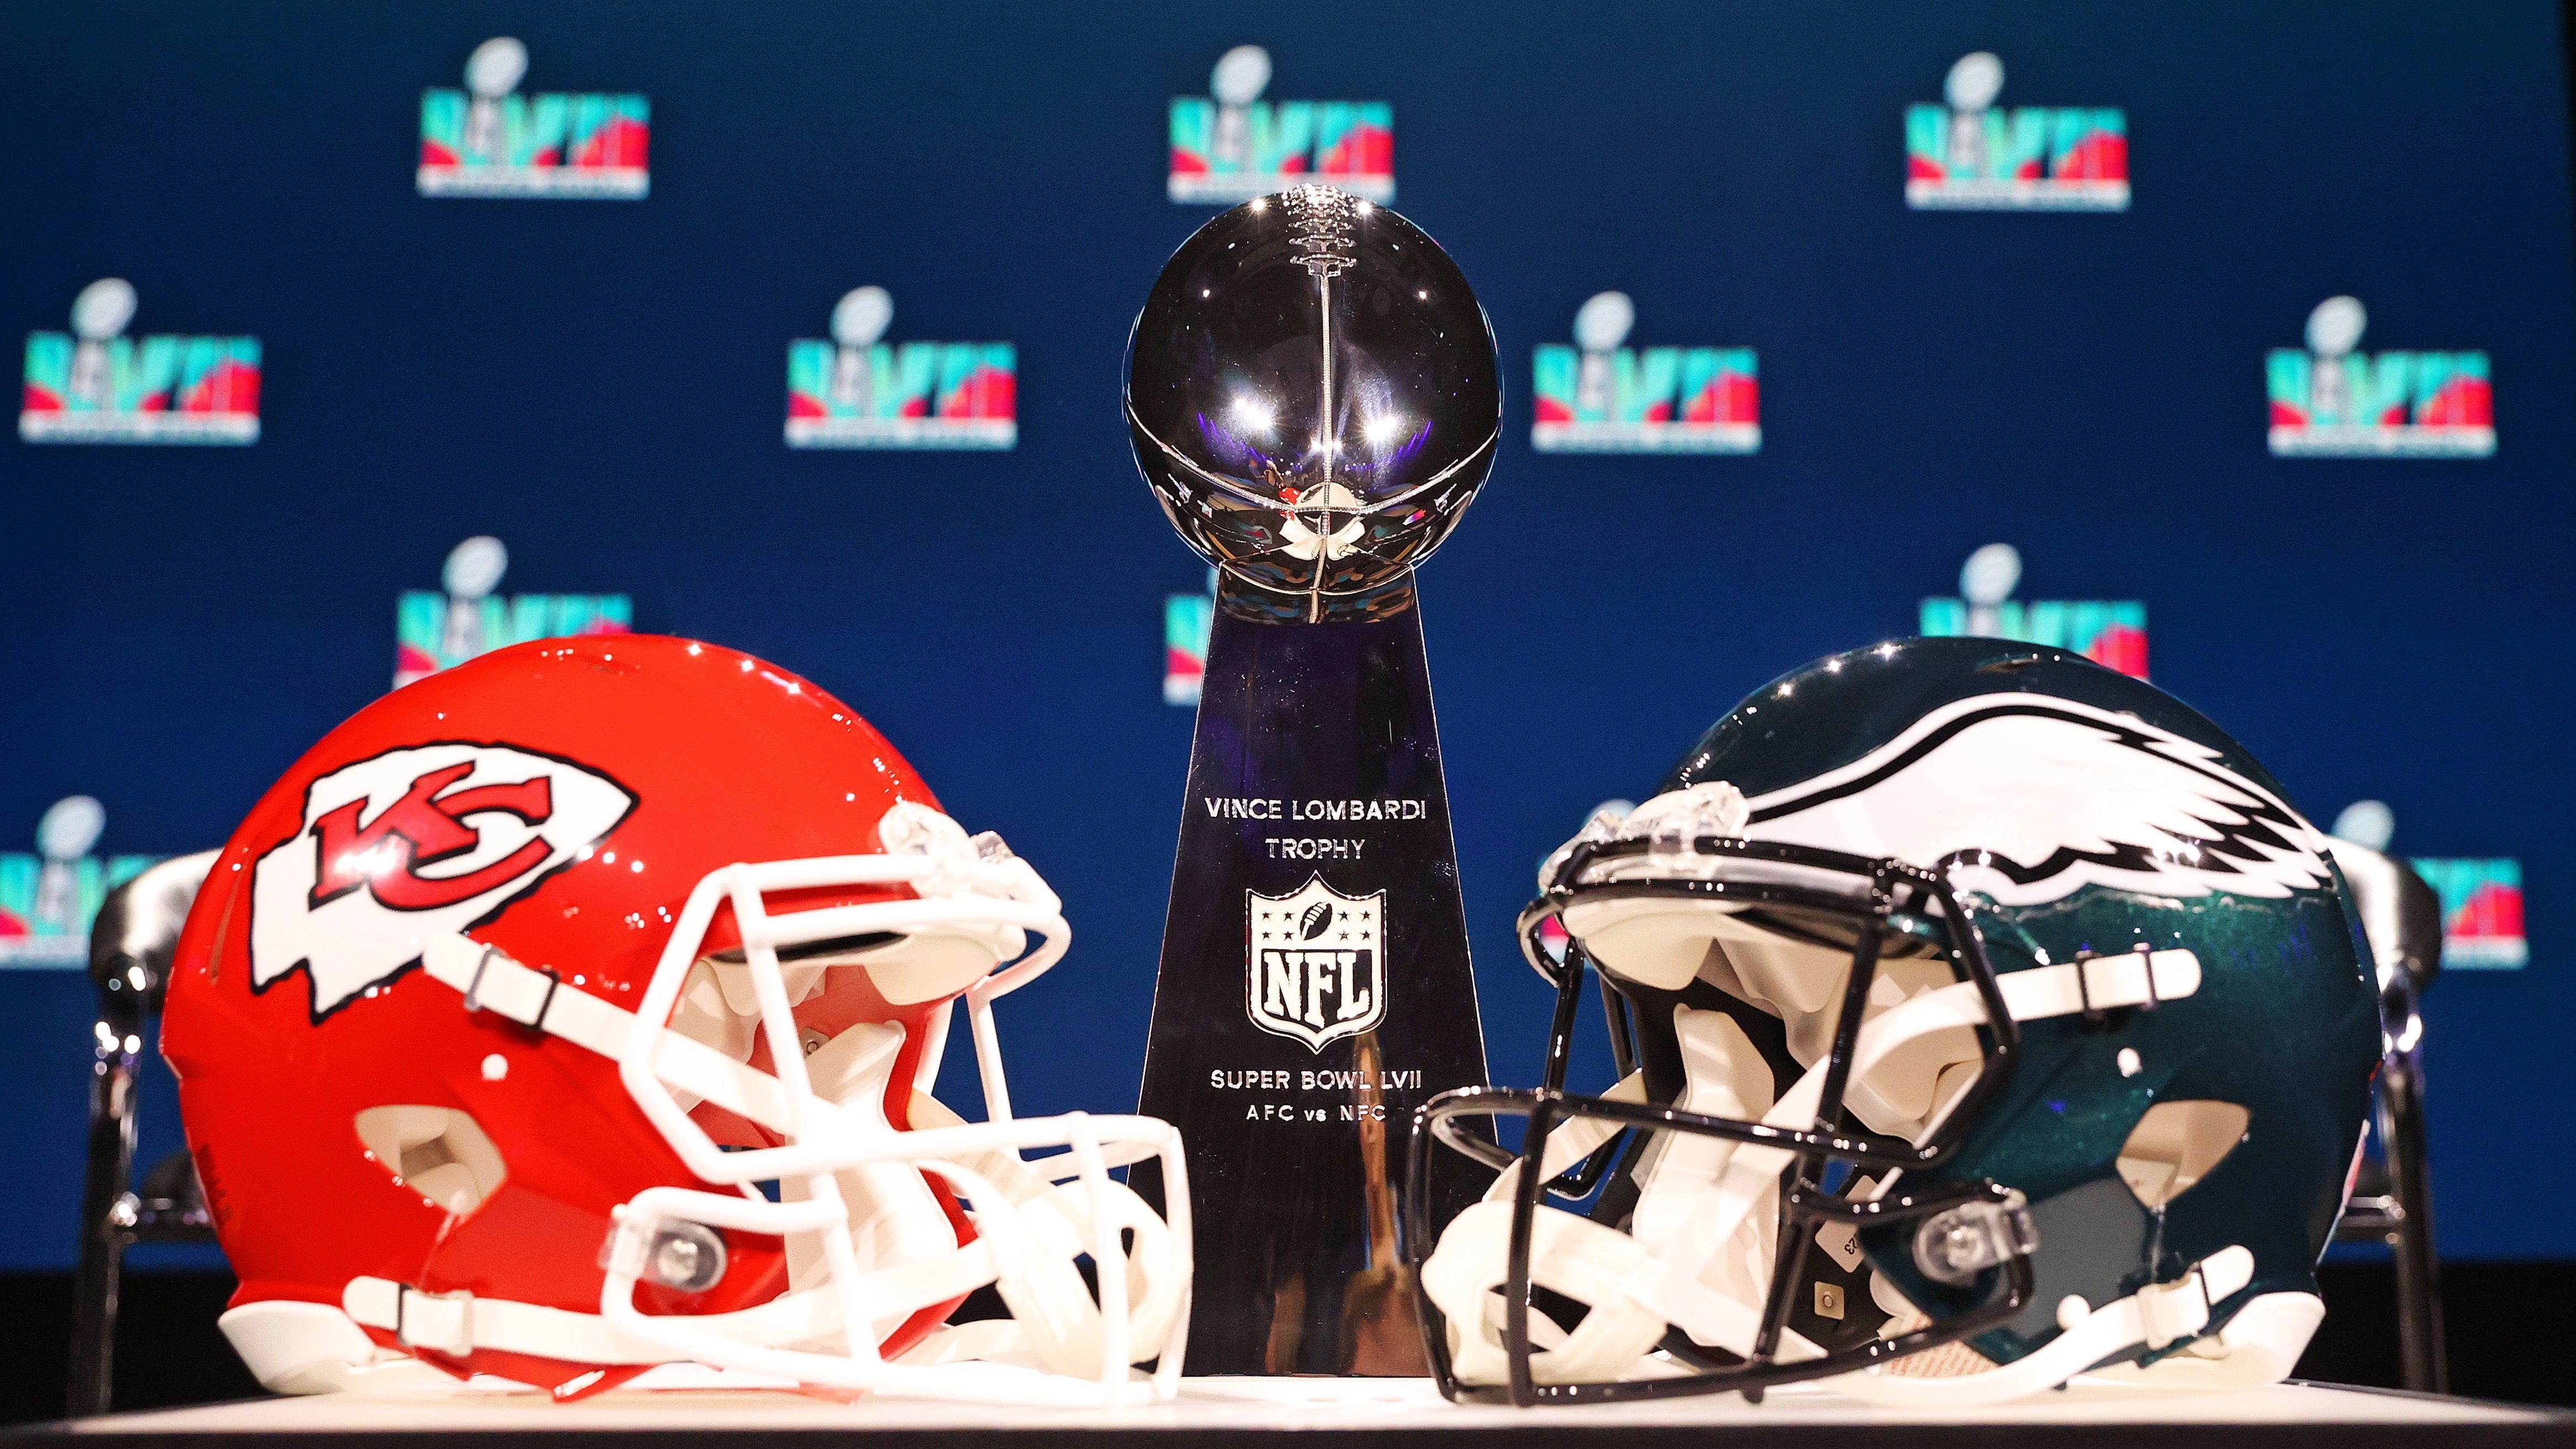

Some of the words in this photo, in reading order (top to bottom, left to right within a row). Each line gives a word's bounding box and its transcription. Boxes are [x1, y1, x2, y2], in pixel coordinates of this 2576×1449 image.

[1204, 797, 1282, 820] VINCE
[1292, 800, 1426, 821] LOMBARDI
[309, 760, 555, 912] KC
[1265, 838, 1365, 859] TROPHY
[1263, 952, 1370, 1029] NFL
[1211, 1069, 1290, 1089] SUPER
[1301, 1070, 1372, 1090] BOWL
[1380, 1070, 1421, 1090] LVII
[1246, 1105, 1294, 1122] AFC
[1304, 1109, 1327, 1122] vs
[1340, 1105, 1386, 1122] NFC
[1844, 1234, 1858, 1255] 23
